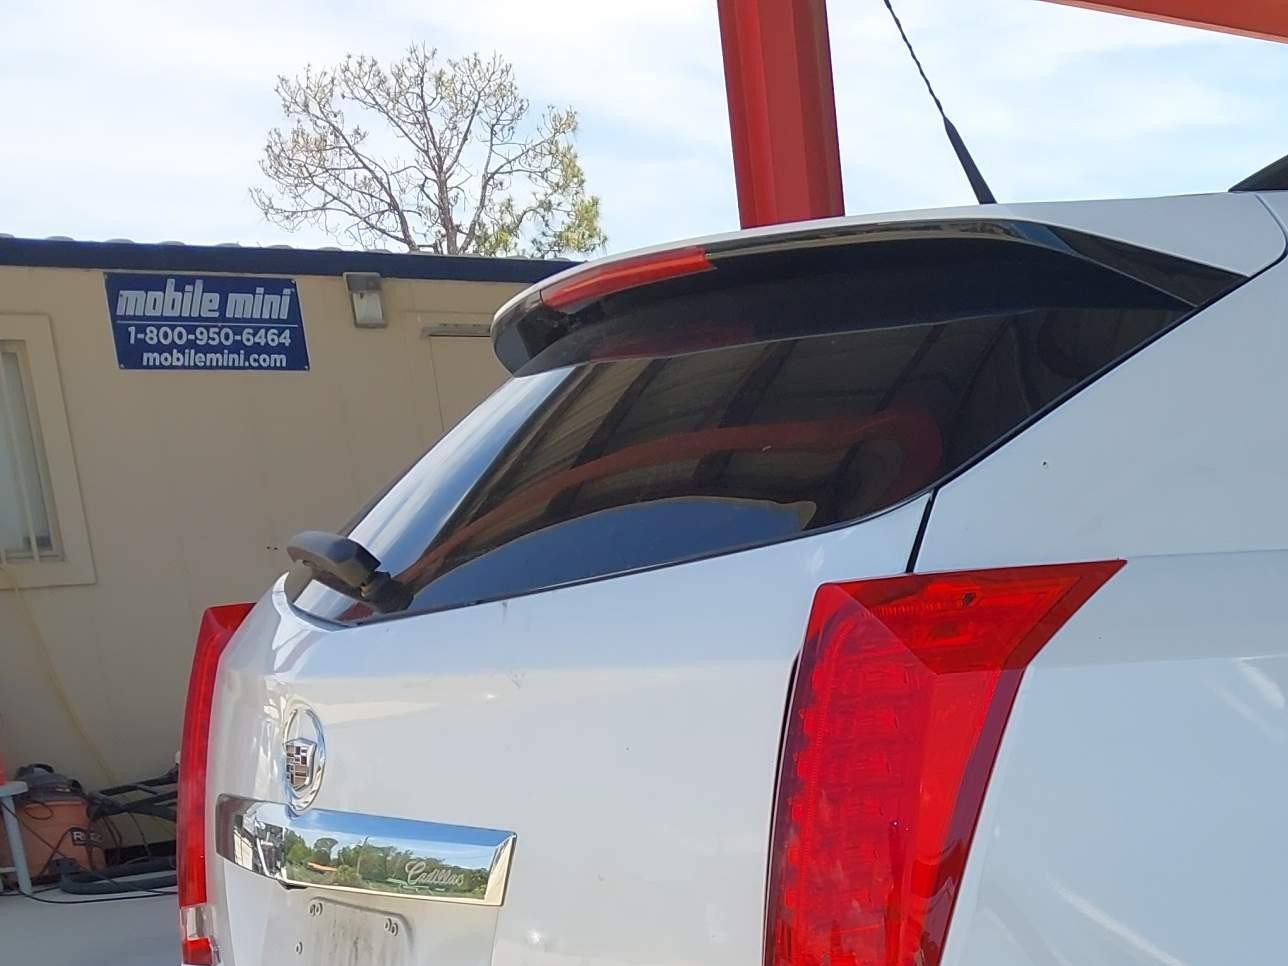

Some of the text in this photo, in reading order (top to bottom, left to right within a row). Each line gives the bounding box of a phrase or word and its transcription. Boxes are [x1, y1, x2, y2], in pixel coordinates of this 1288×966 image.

[116, 278, 292, 320] mobile mini
[128, 326, 291, 347] 1-800-950-6464
[142, 349, 287, 367] mobilemini.com
